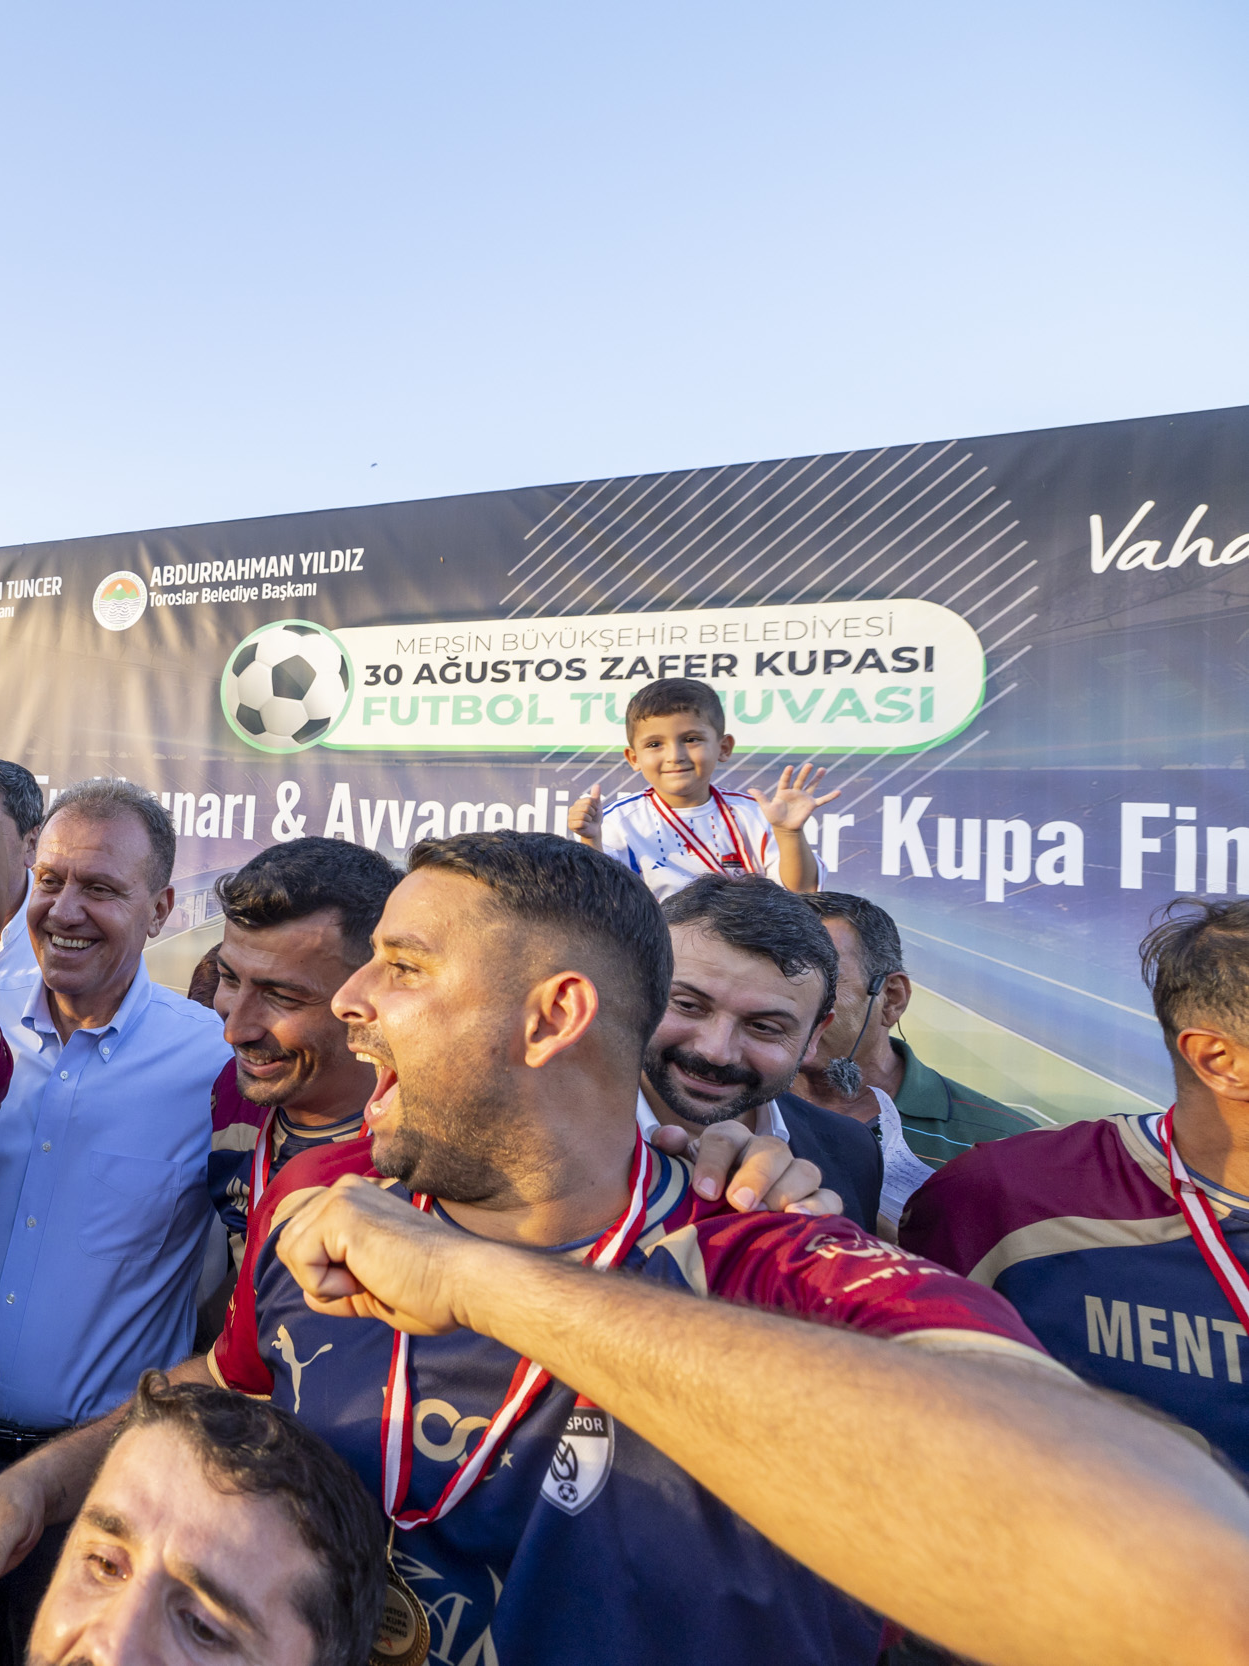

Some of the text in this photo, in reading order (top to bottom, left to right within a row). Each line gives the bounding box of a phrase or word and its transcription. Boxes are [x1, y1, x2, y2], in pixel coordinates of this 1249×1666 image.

[149, 548, 365, 587] ABDURRAHMAN YILDIZ
[6, 576, 62, 600] TUNCER
[149, 581, 317, 607] Toroslar Belediye Başkanı
[395, 611, 894, 655] MERSİN BÜYÜKŞEHİR BELEDİYESİ
[363, 645, 934, 686] 30 AĞUSTOS ZAFER KUPASI
[362, 686, 934, 726] FUTBOL TUUVASI
[271, 780, 307, 842] &
[881, 795, 1085, 903] Kupa
[1085, 1295, 1249, 1384] MENT
[566, 1416, 604, 1432] SPOR
